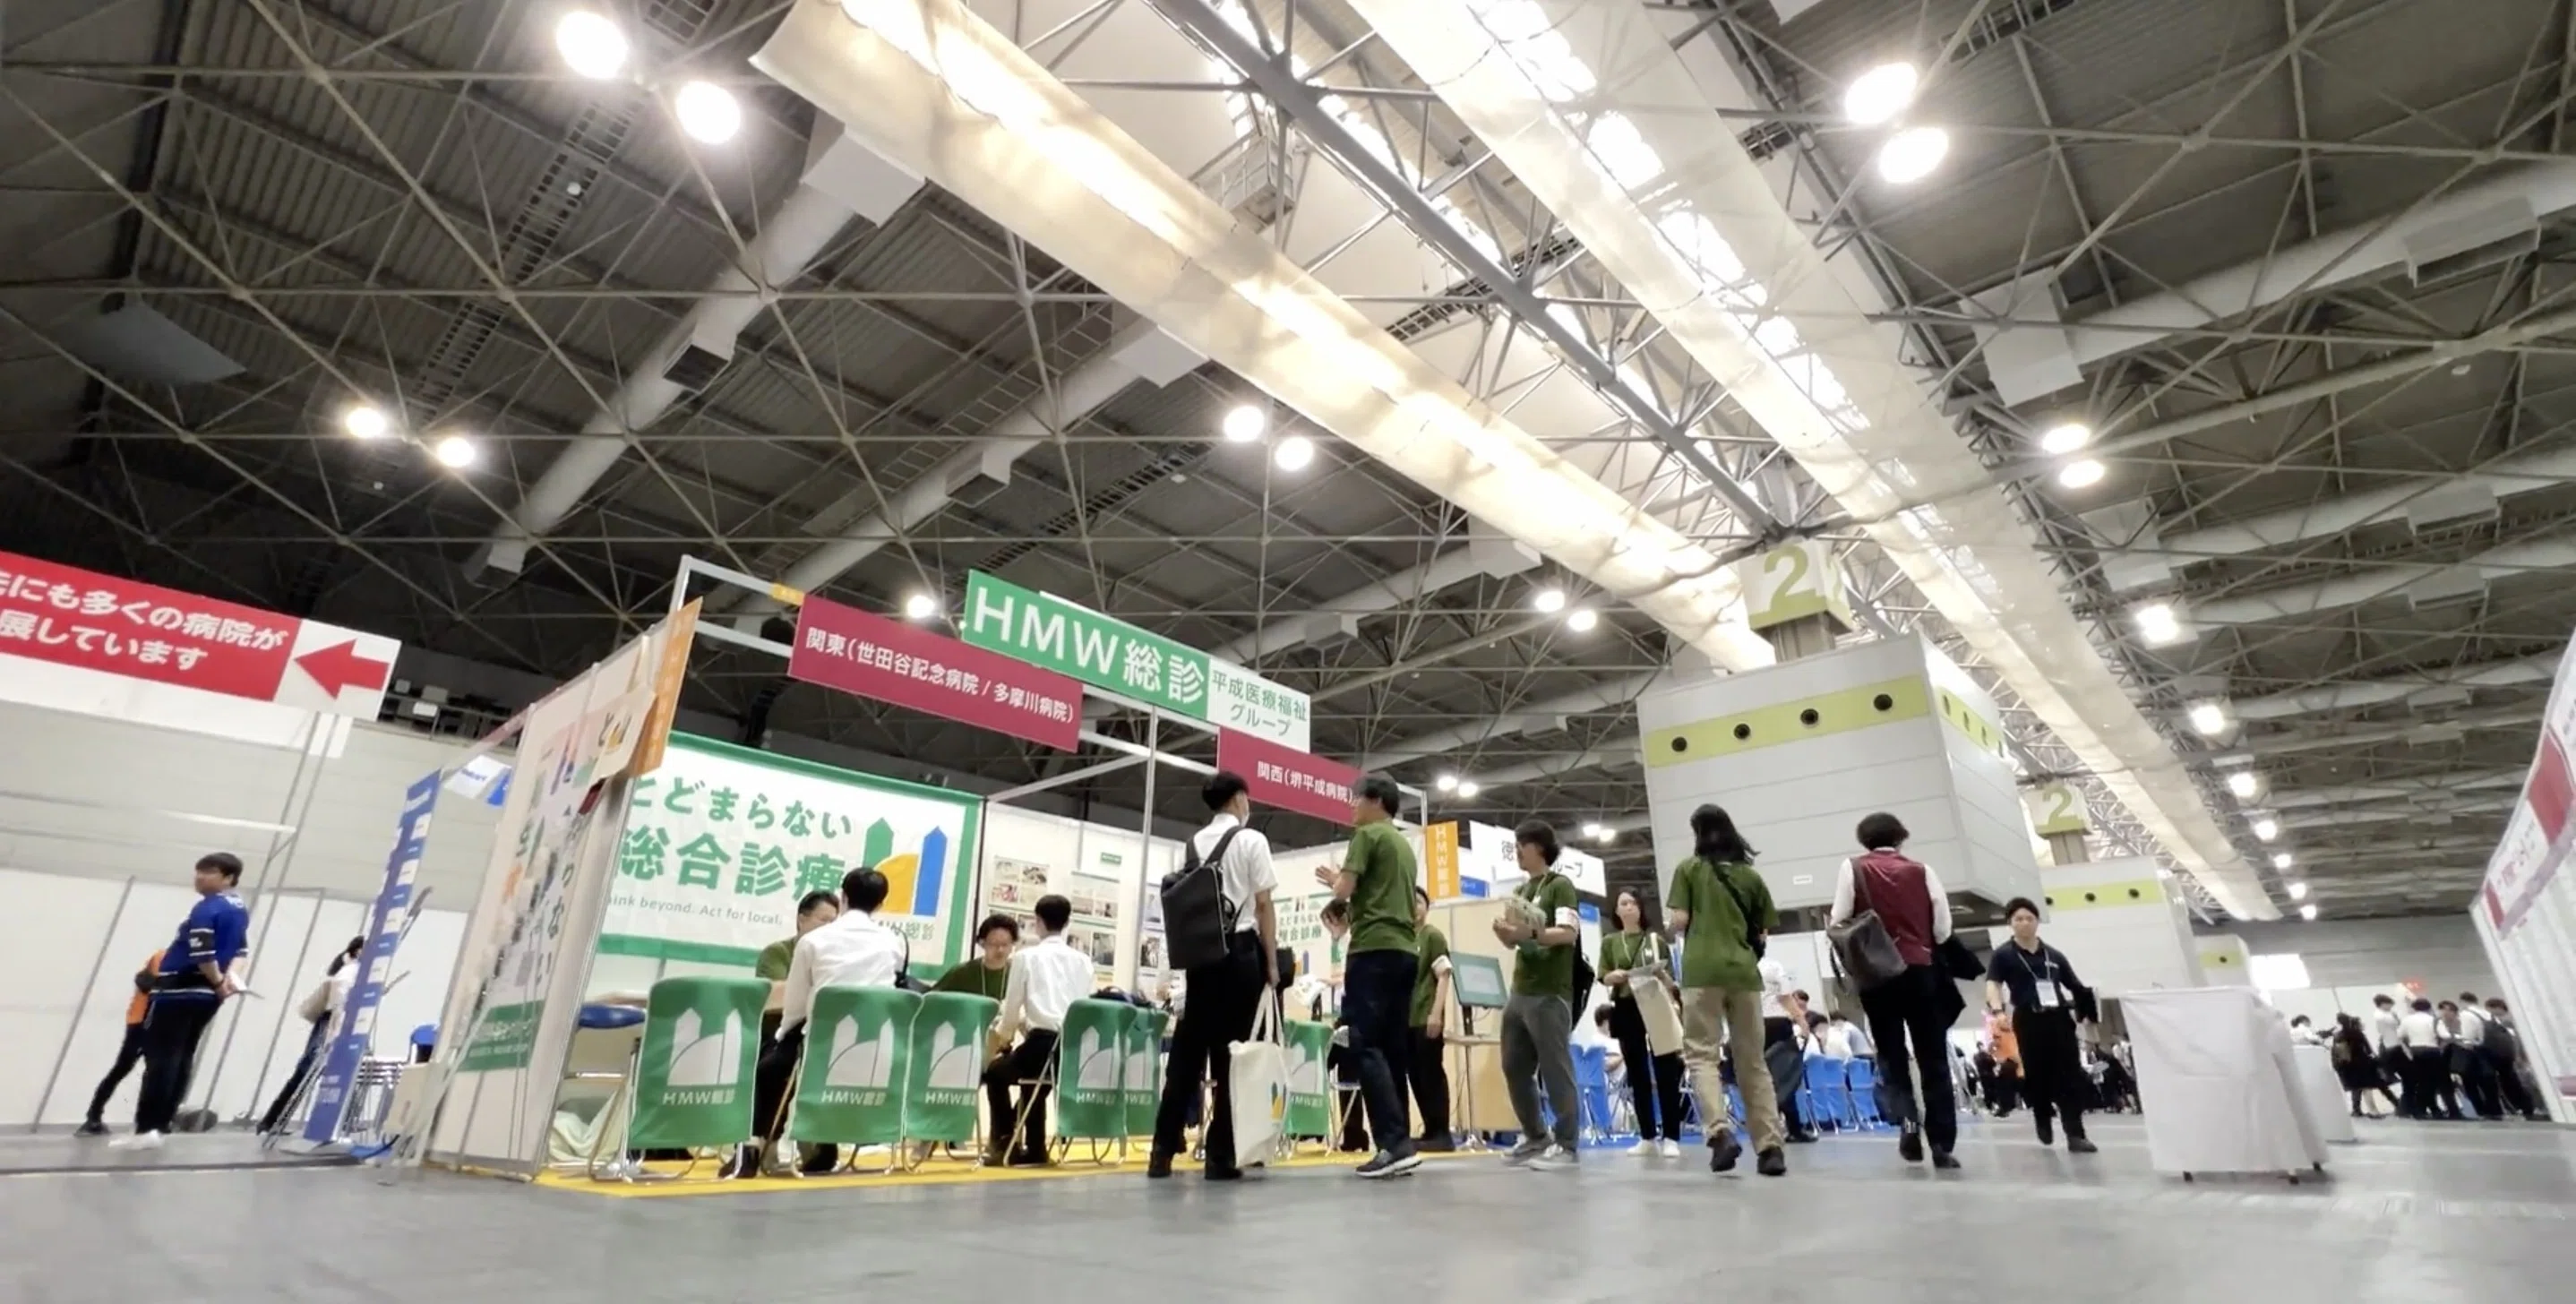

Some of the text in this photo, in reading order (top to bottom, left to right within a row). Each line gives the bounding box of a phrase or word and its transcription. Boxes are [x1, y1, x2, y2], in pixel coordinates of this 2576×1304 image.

[1765, 544, 1816, 612] 2
[974, 587, 1204, 705] HMW総診
[1212, 670, 1308, 722] 平成医療福祉
[1230, 703, 1292, 736] グループ
[2042, 786, 2079, 828] 2
[621, 824, 846, 901] 総合診療
[640, 896, 695, 913] beyond.
[699, 905, 722, 917] Act
[726, 906, 745, 920] for
